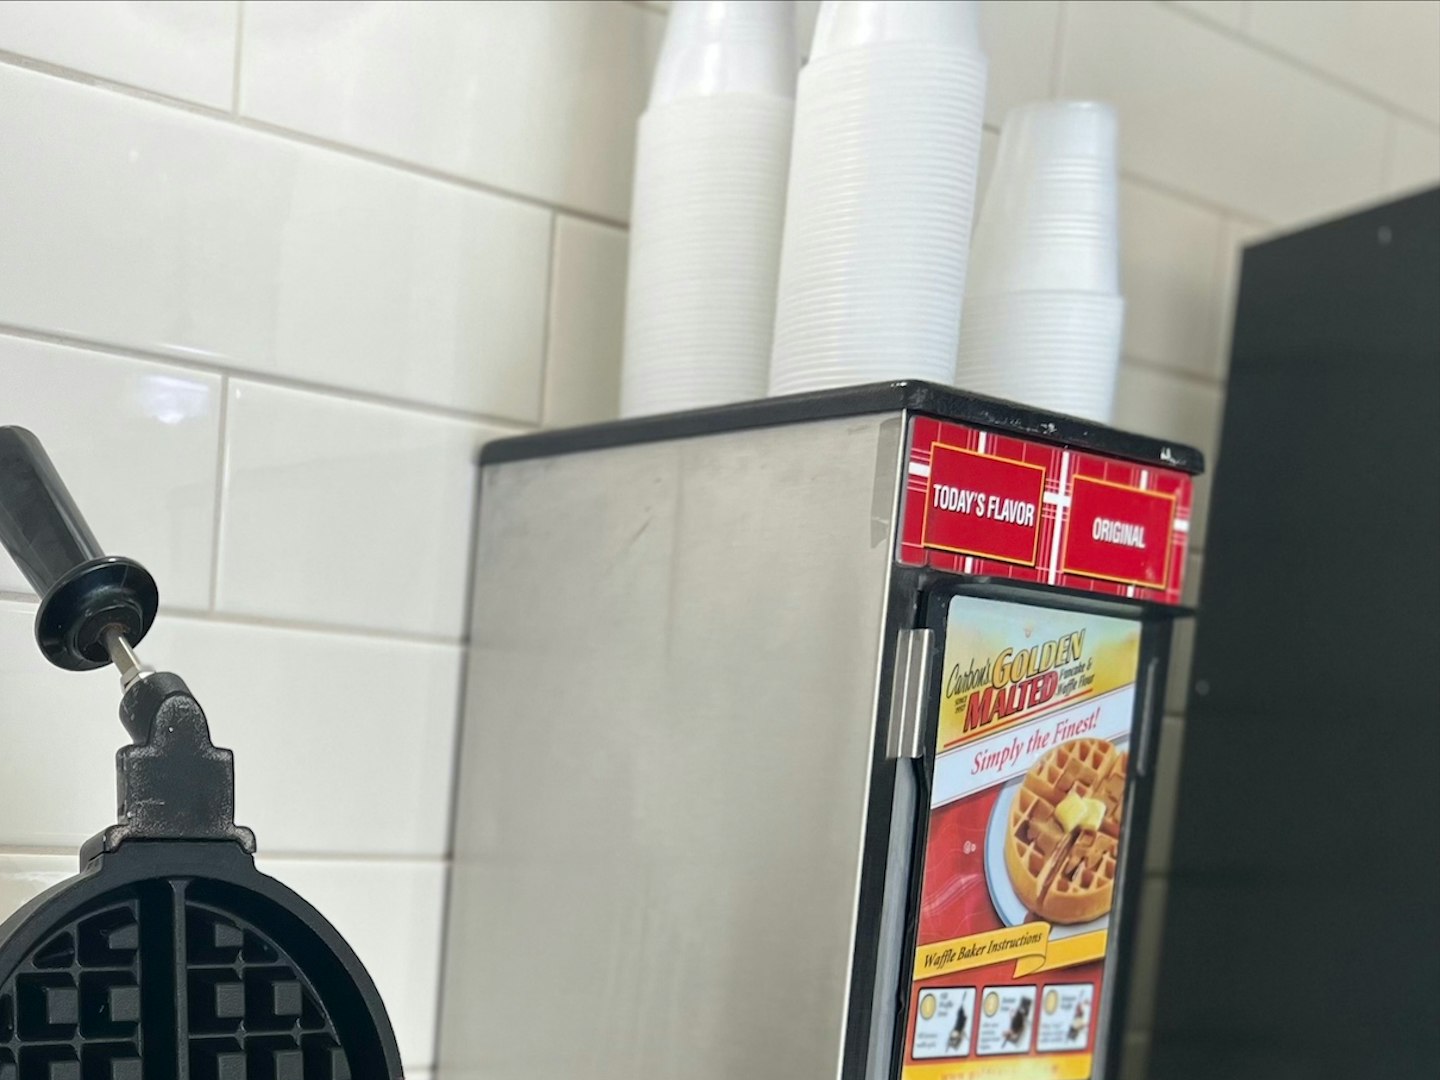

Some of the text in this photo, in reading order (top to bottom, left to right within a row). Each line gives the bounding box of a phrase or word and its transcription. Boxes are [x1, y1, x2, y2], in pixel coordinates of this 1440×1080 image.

[933, 483, 1035, 527] TODAY'S FLAVOR
[1092, 517, 1146, 548] ORIGINAL
[991, 628, 1086, 690] GOLDEN
[963, 670, 1059, 734] MALTED
[971, 706, 1101, 776] Simply the Finest!
[924, 931, 1043, 970] Waffle Baker Instructions
